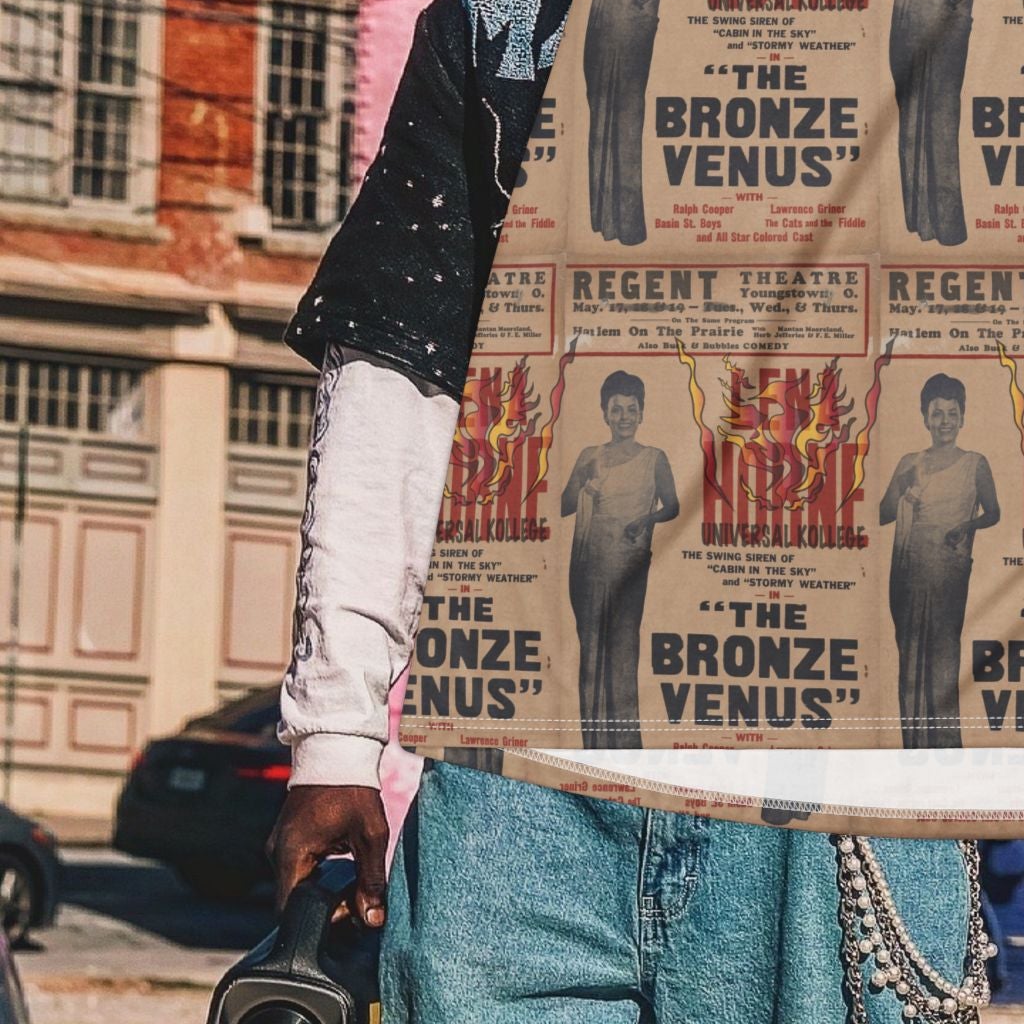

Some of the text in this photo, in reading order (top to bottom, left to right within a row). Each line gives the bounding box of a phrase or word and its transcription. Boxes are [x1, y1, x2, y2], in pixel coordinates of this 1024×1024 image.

[1002, 16, 1023, 25] THE
[652, 96, 860, 139] BRONZE
[975, 219, 1000, 228] Basin
[1004, 219, 1017, 228] St.
[994, 204, 1019, 216] Ralph
[415, 628, 543, 672] ONZE
[651, 635, 858, 680] BRONZE
[403, 677, 544, 720] ENUS”
